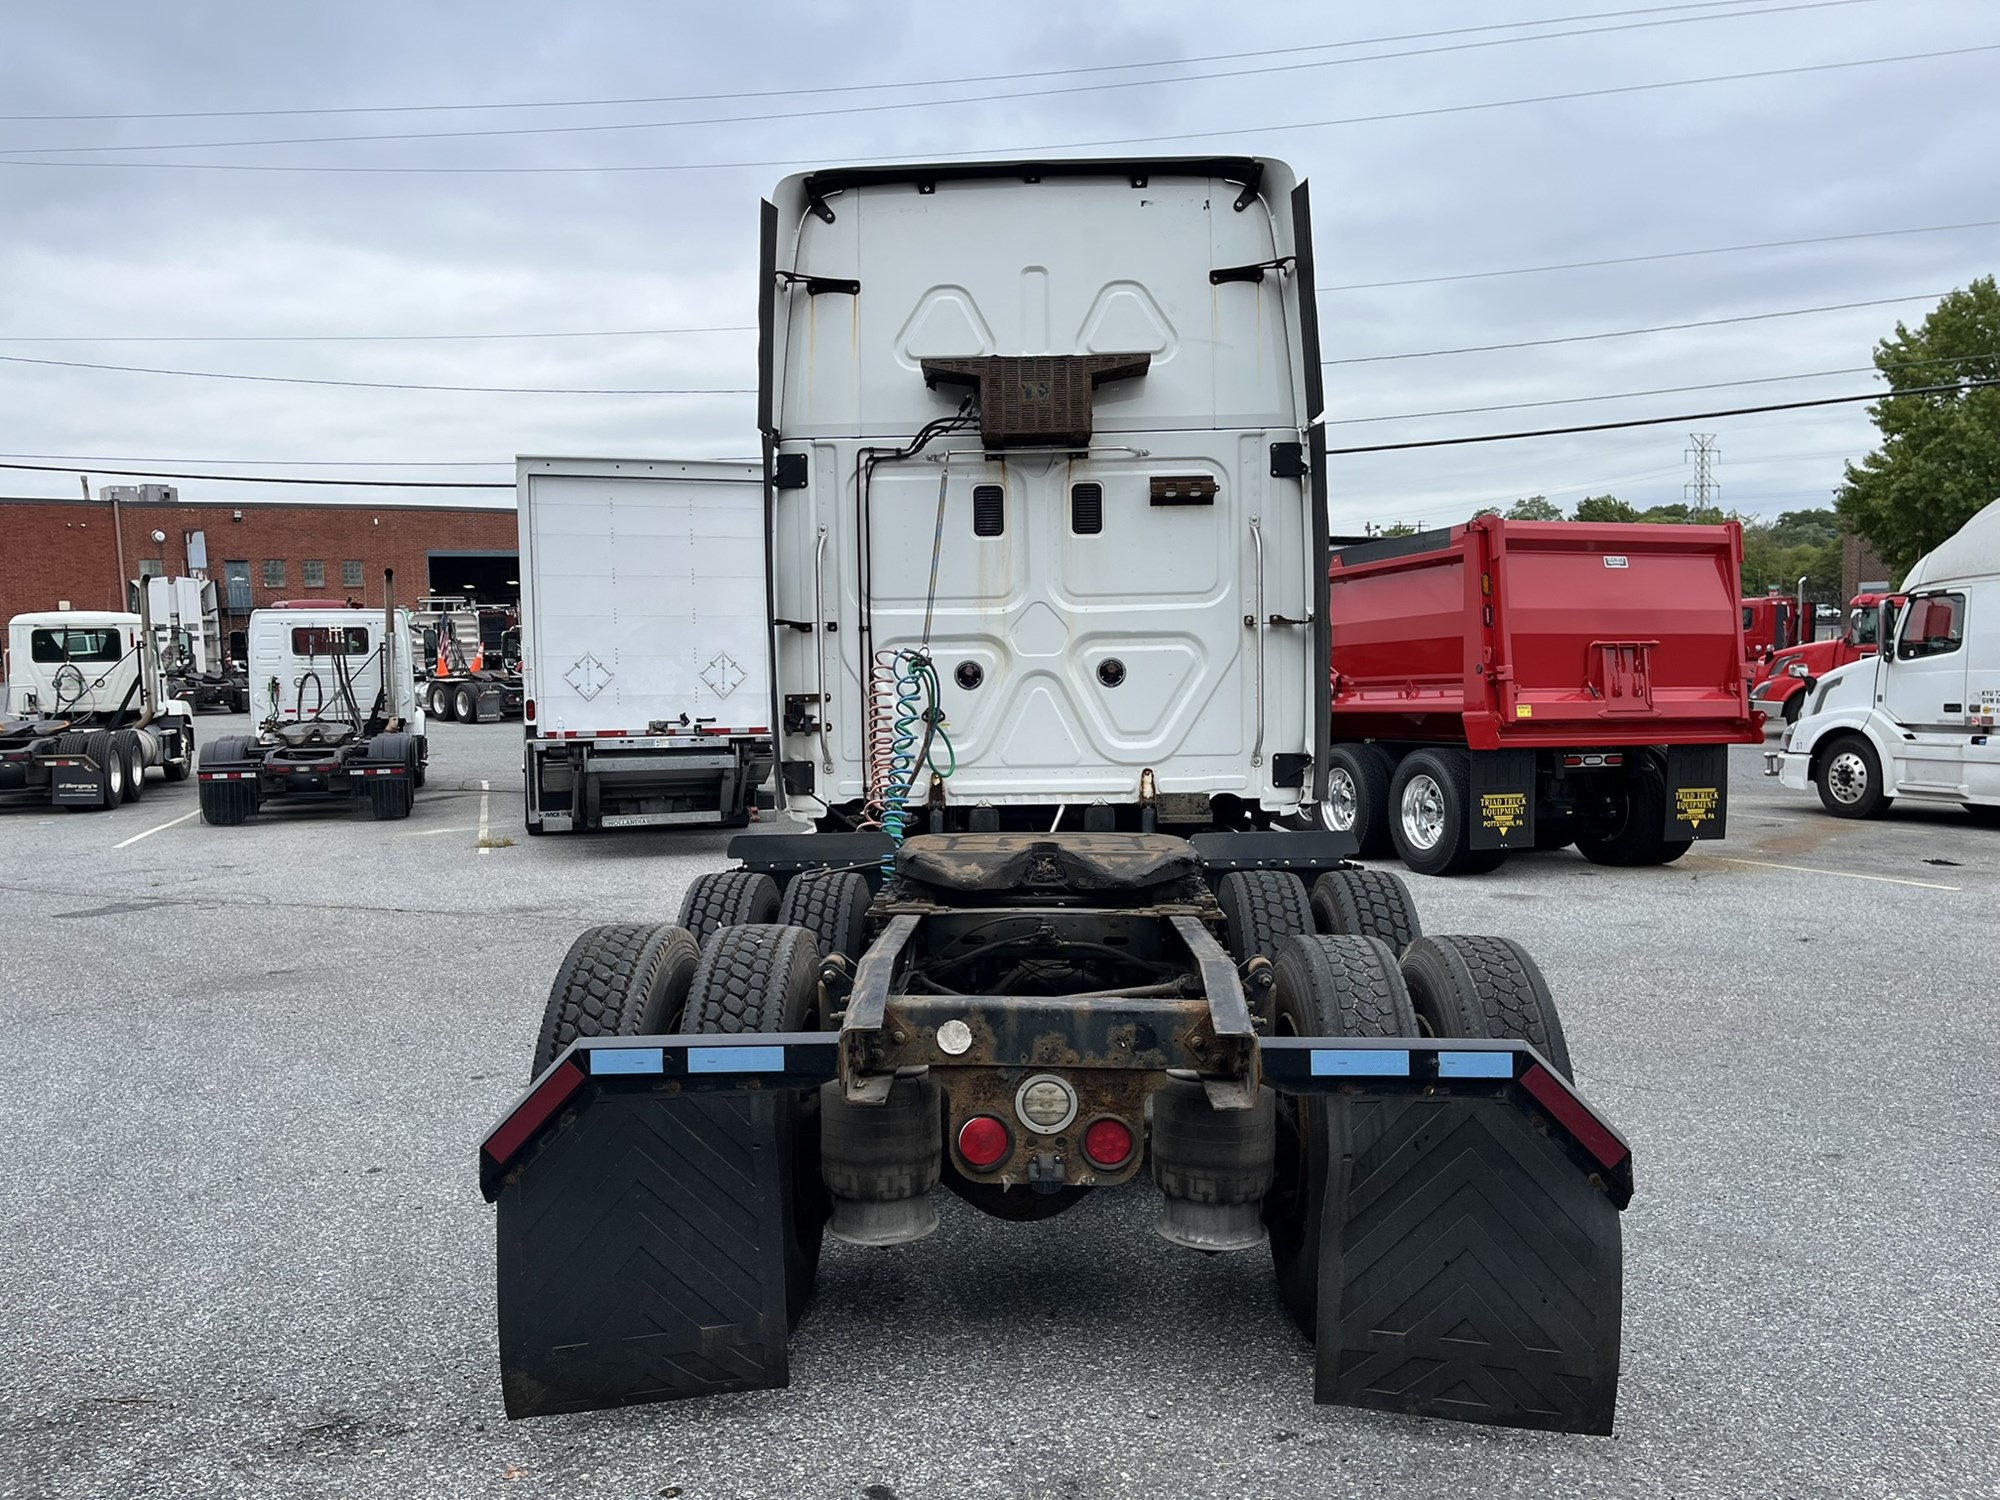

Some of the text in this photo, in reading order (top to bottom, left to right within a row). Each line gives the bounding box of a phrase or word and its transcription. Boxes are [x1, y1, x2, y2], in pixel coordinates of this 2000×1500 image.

[1675, 791, 1719, 800] TRIAD TRUCK
[1480, 797, 1527, 806] TRIAD TRUCK
[1677, 801, 1716, 810] EQUIPMENT
[1483, 807, 1524, 817] EQUIPMENT
